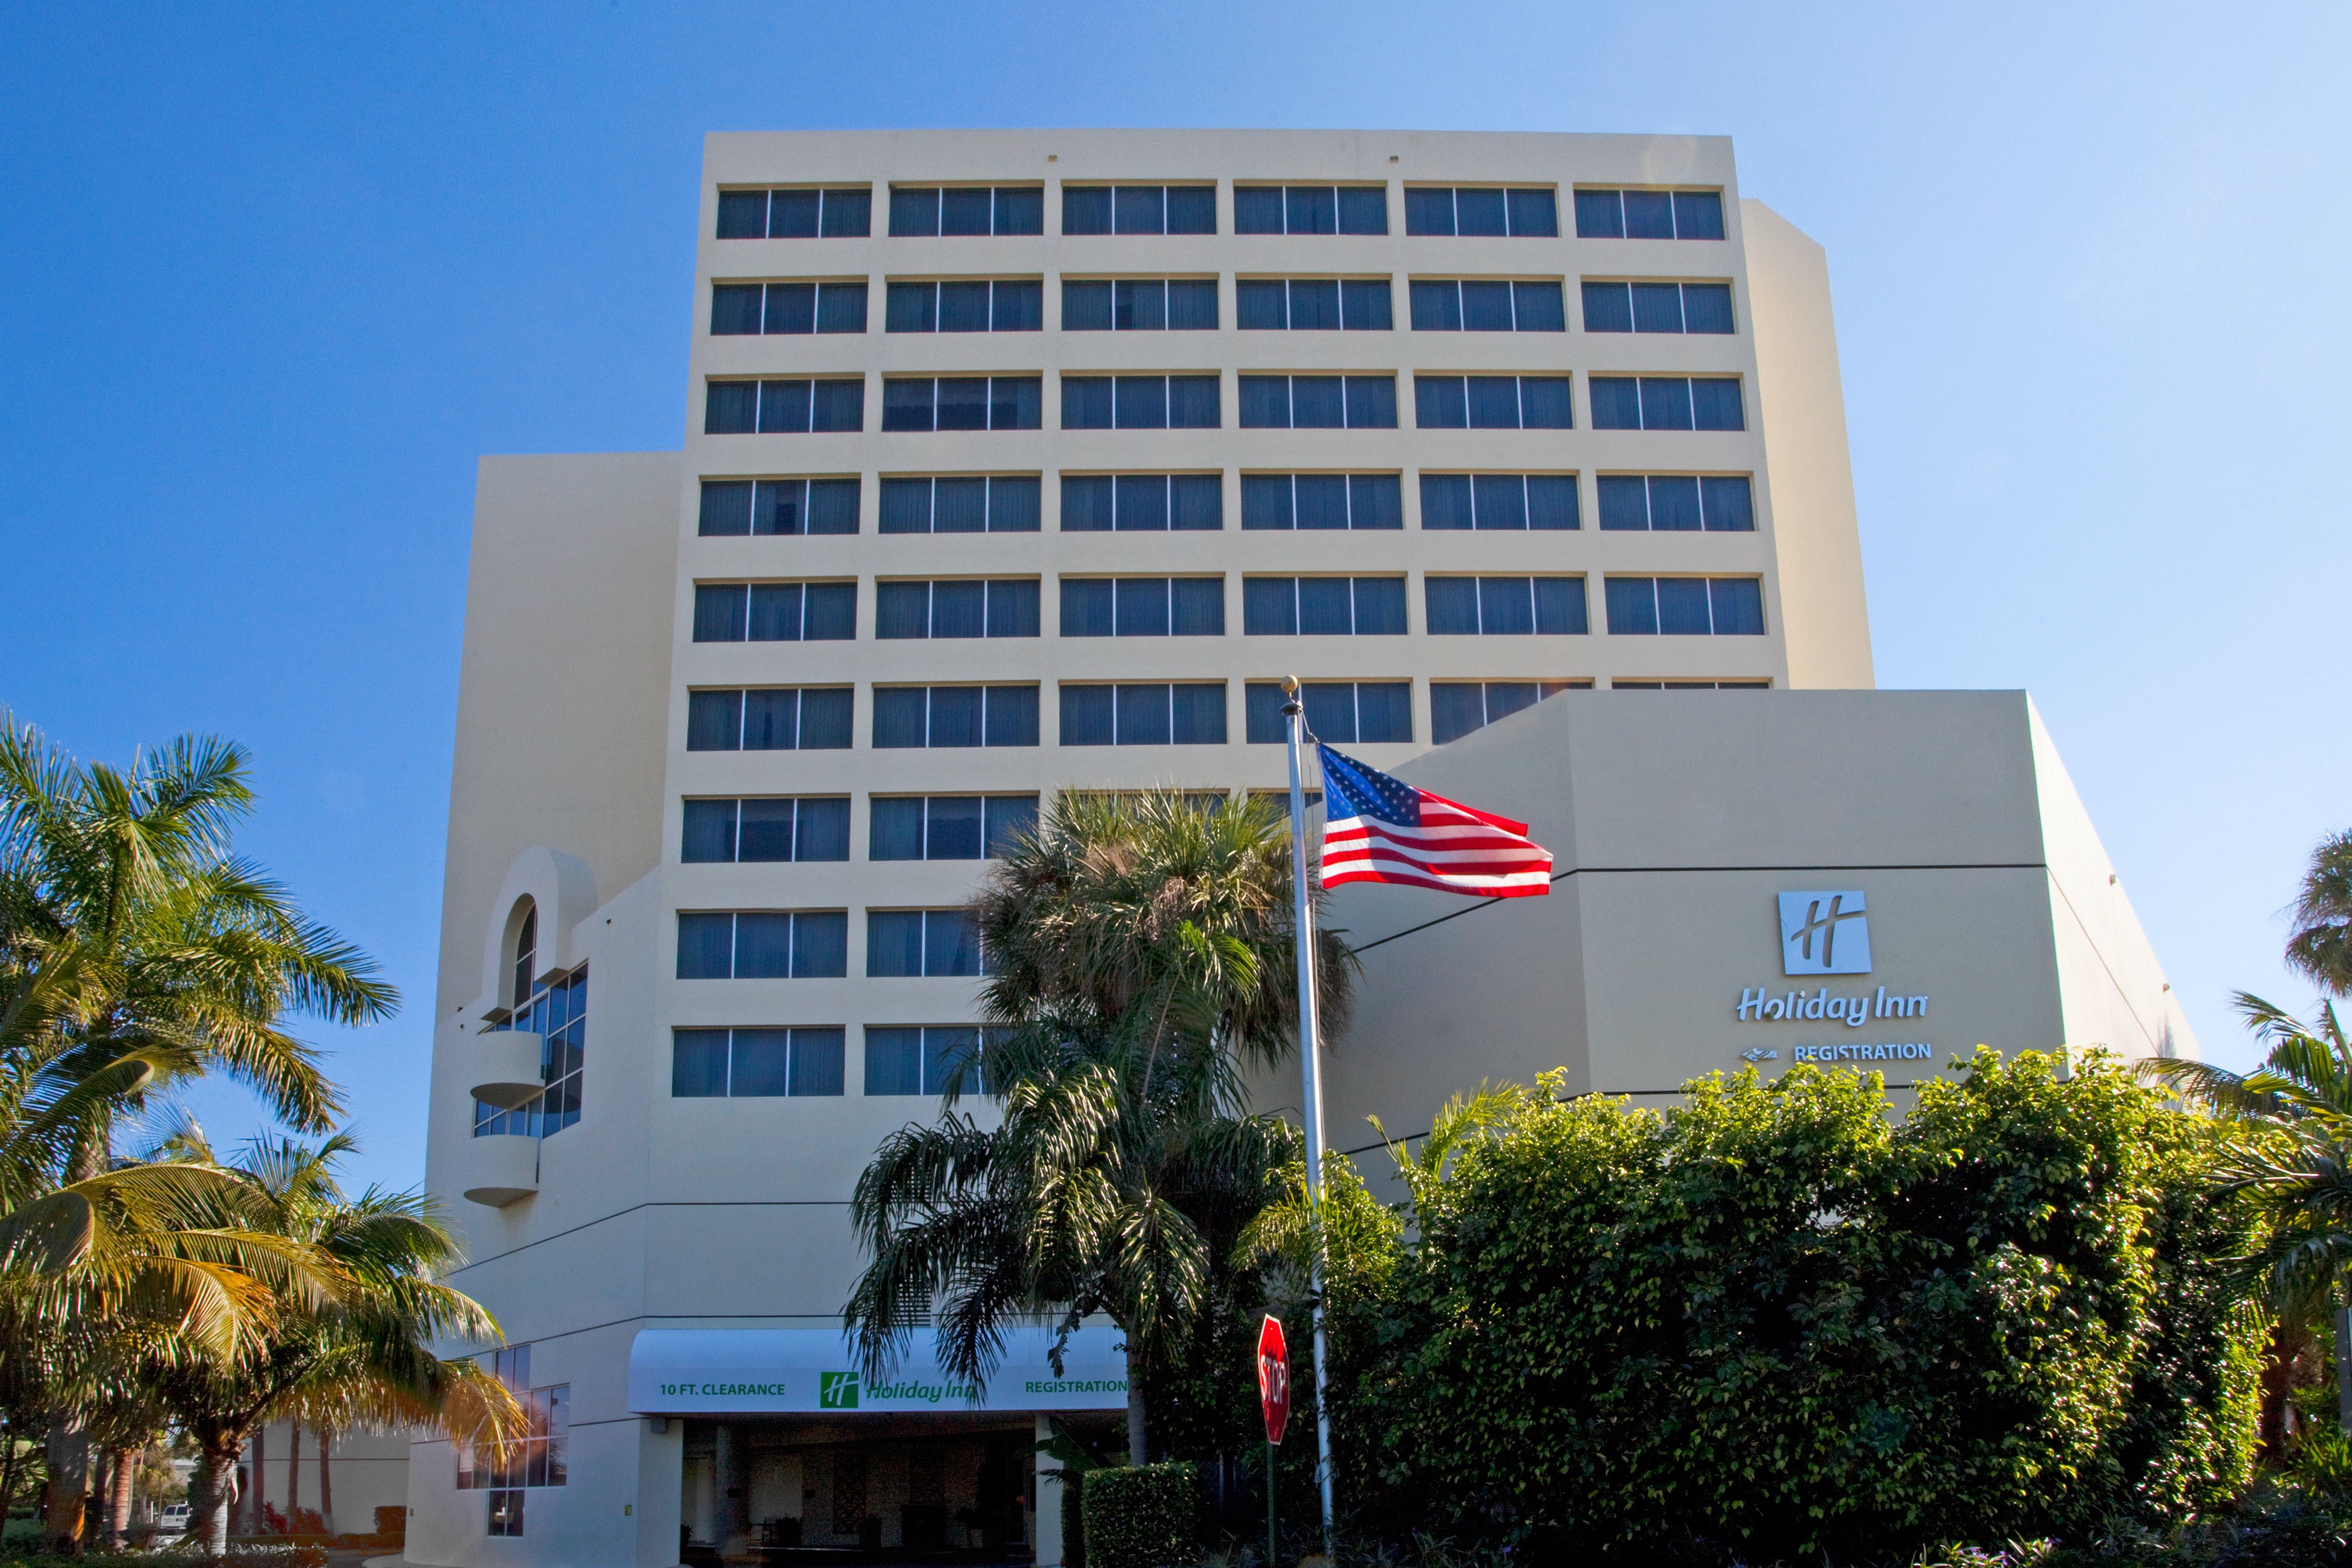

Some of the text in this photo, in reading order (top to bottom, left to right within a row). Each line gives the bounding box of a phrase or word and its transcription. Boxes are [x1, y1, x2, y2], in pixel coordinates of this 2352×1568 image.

[1736, 986, 1928, 1026] Holiday Inn
[1794, 1044, 1931, 1061] REGISTRATION
[1026, 1381, 1128, 1392] REGISTRATION
[1260, 1354, 1286, 1404] STOP
[661, 1384, 785, 1395] 10 FT. CLEARANCE
[866, 1380, 942, 1403] Holiday
